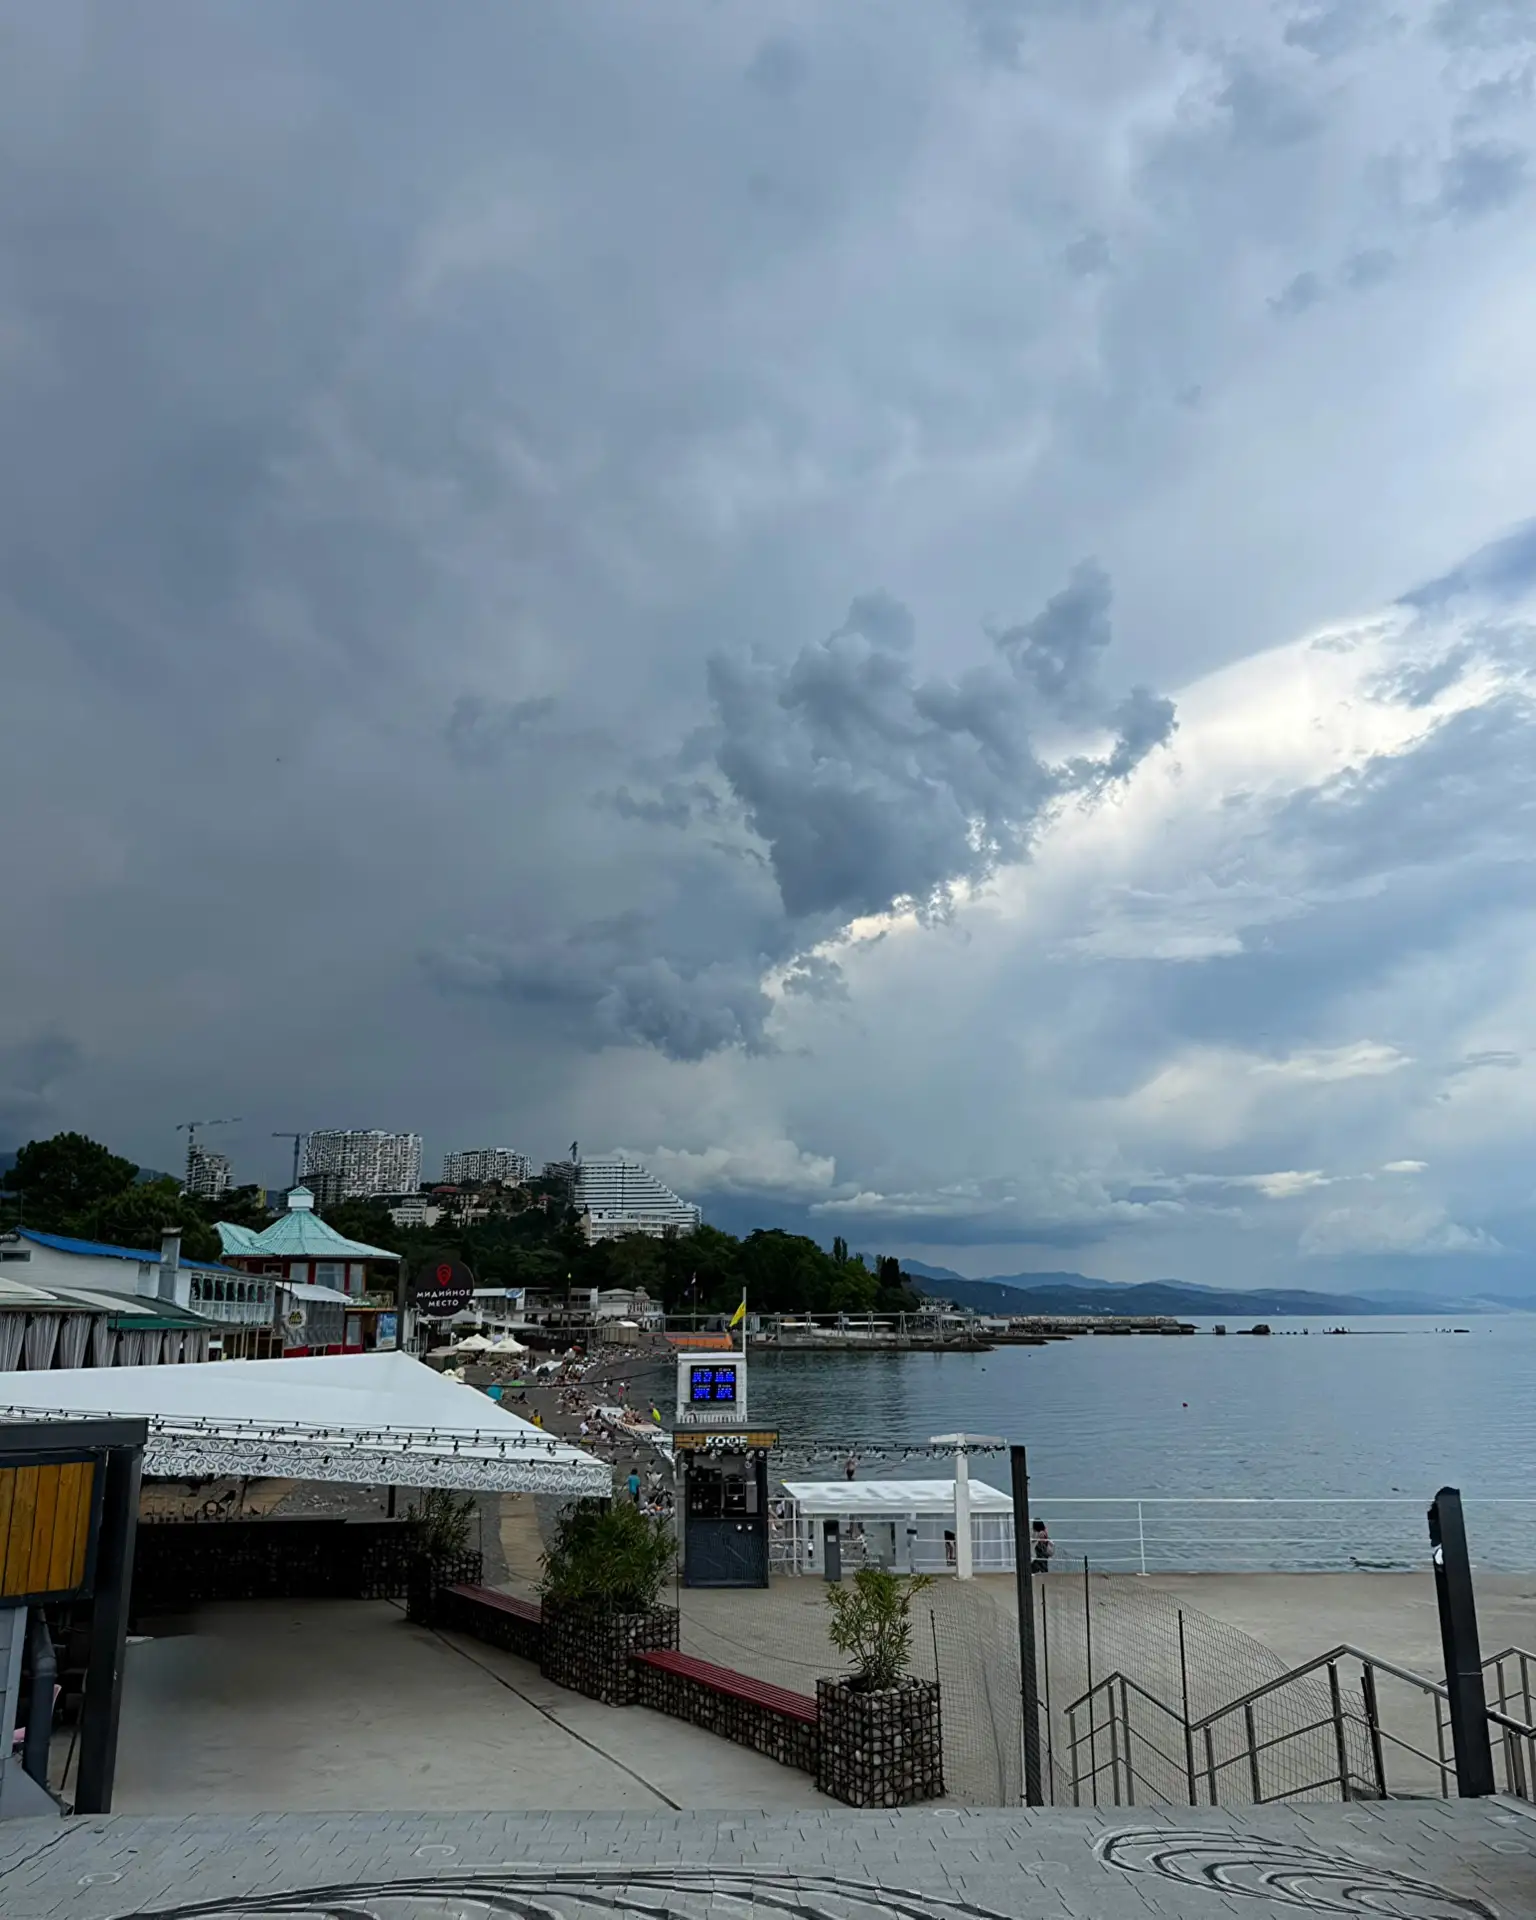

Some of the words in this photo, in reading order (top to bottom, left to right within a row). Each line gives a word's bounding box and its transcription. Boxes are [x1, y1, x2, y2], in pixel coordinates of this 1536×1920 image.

[416, 1288, 471, 1298] МИДИЙНОЕ
[428, 1299, 459, 1307] МЕСТО
[706, 1436, 748, 1447] КОФЕ
